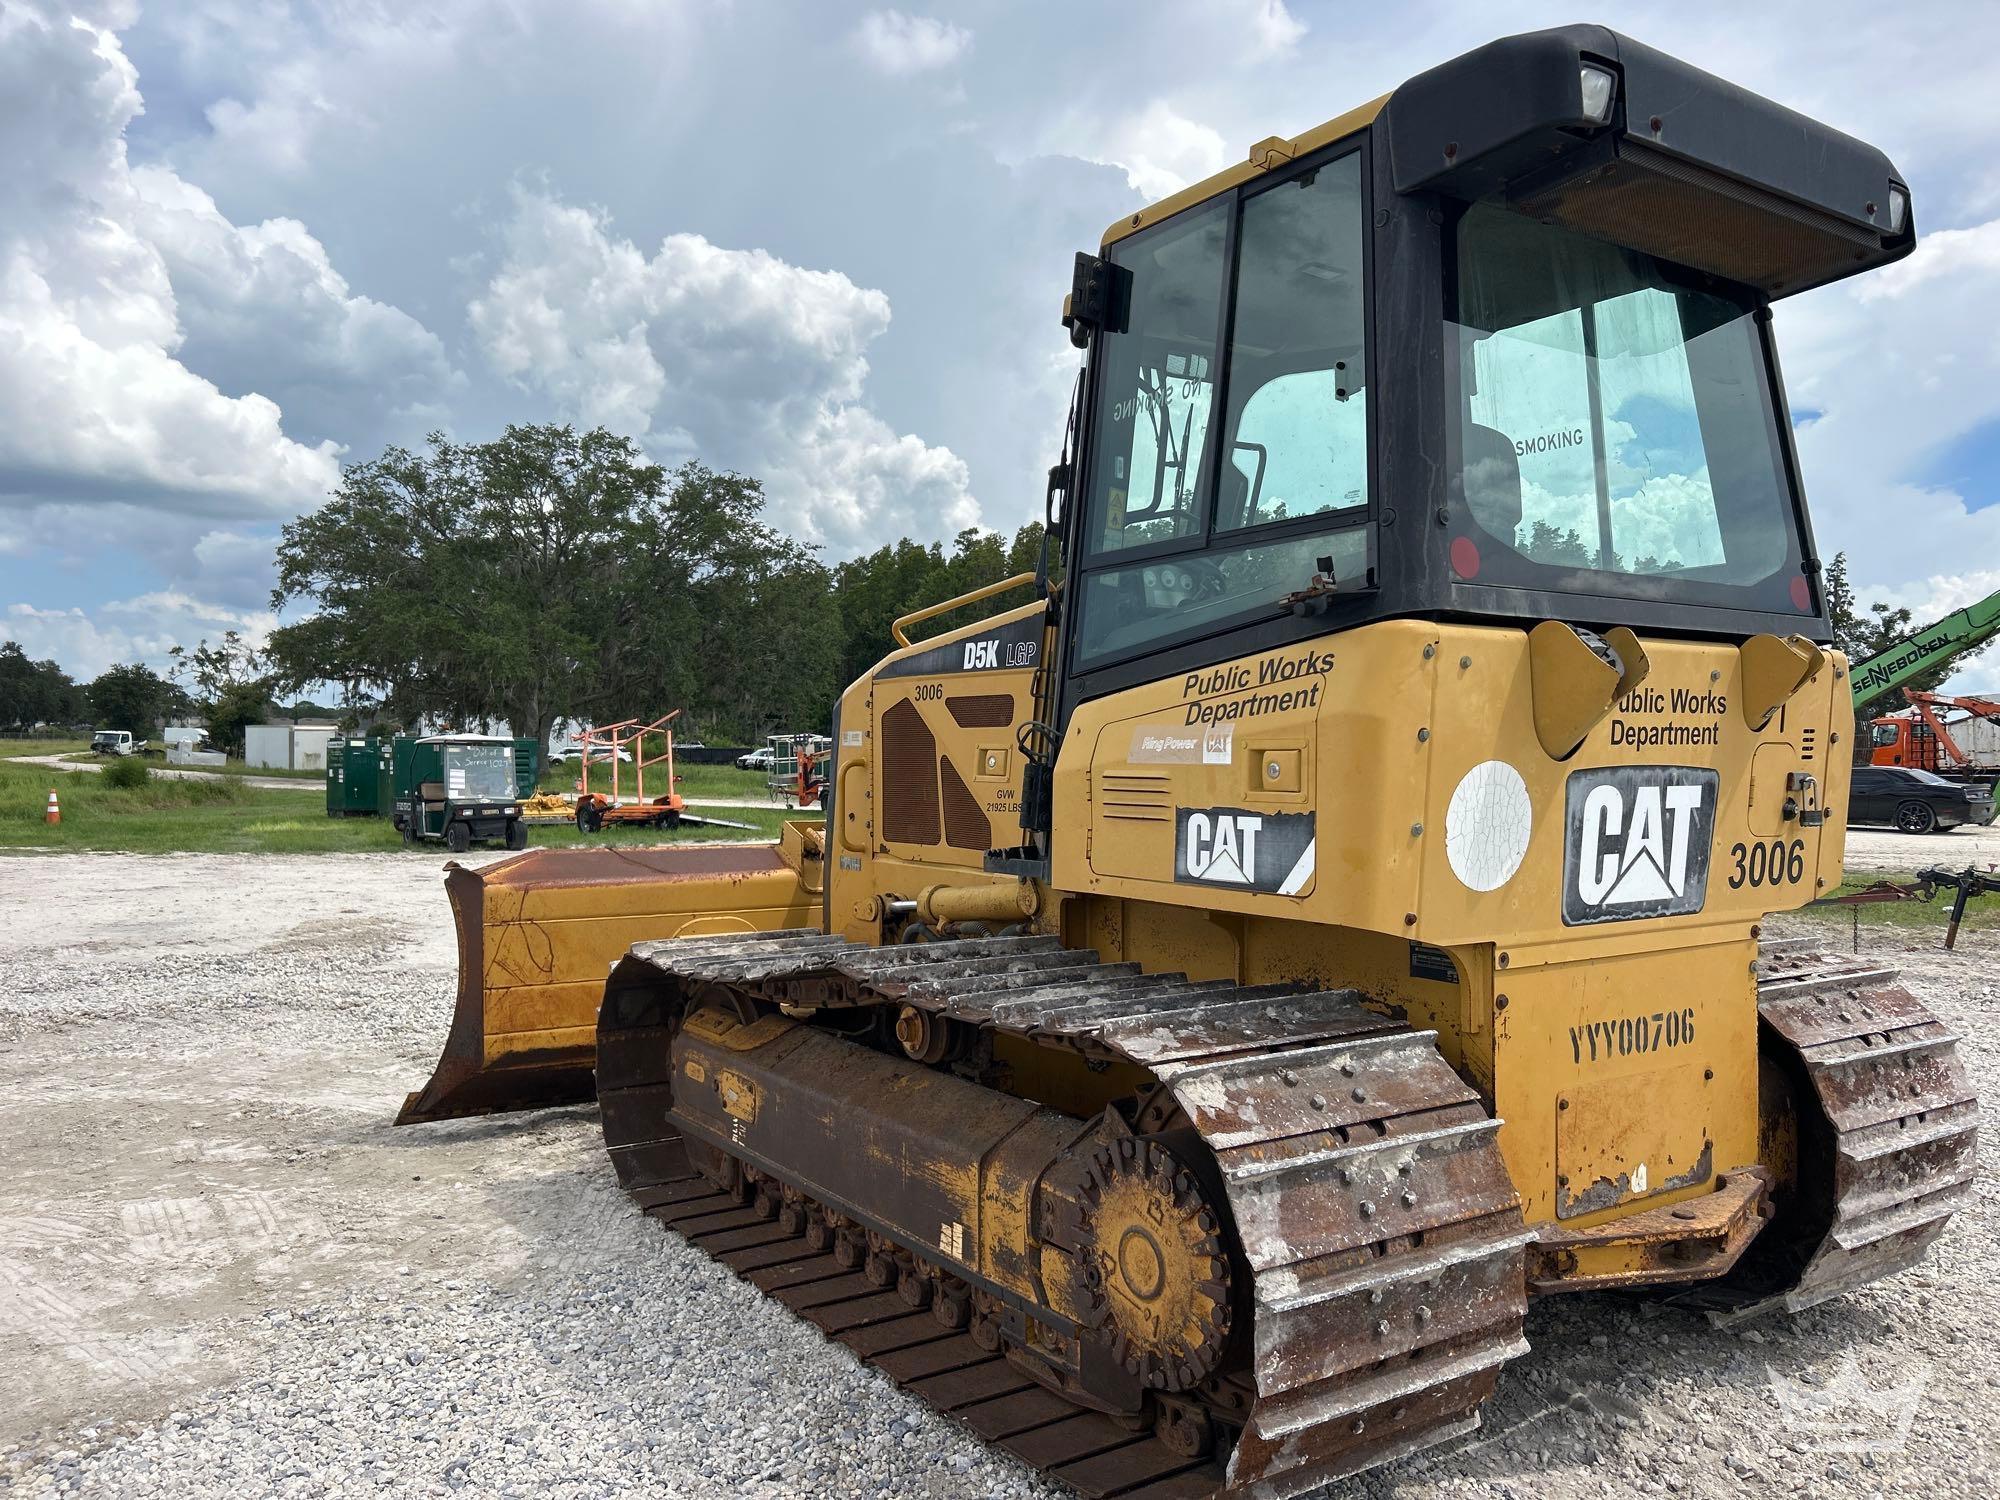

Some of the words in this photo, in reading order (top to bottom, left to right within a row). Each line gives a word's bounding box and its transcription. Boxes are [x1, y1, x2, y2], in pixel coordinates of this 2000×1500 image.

[1515, 428, 1583, 457] SMOKING
[963, 639, 1000, 670] D5K
[1005, 641, 1037, 667] LGP
[1183, 665, 1250, 698] Public
[1258, 650, 1335, 684] Works
[914, 683, 943, 702] 3006
[1184, 682, 1319, 729] Department
[1617, 687, 1665, 714] ublic
[1670, 688, 1727, 715] Works
[1163, 736, 1198, 750] Power
[1610, 719, 1719, 752] Department
[986, 802, 1007, 812] 21925
[996, 789, 1015, 799] GVW
[1186, 812, 1262, 884] CAT
[1578, 784, 1702, 906] CAT
[1728, 839, 1805, 889] 3006
[1568, 1007, 1695, 1065] YYY00706
